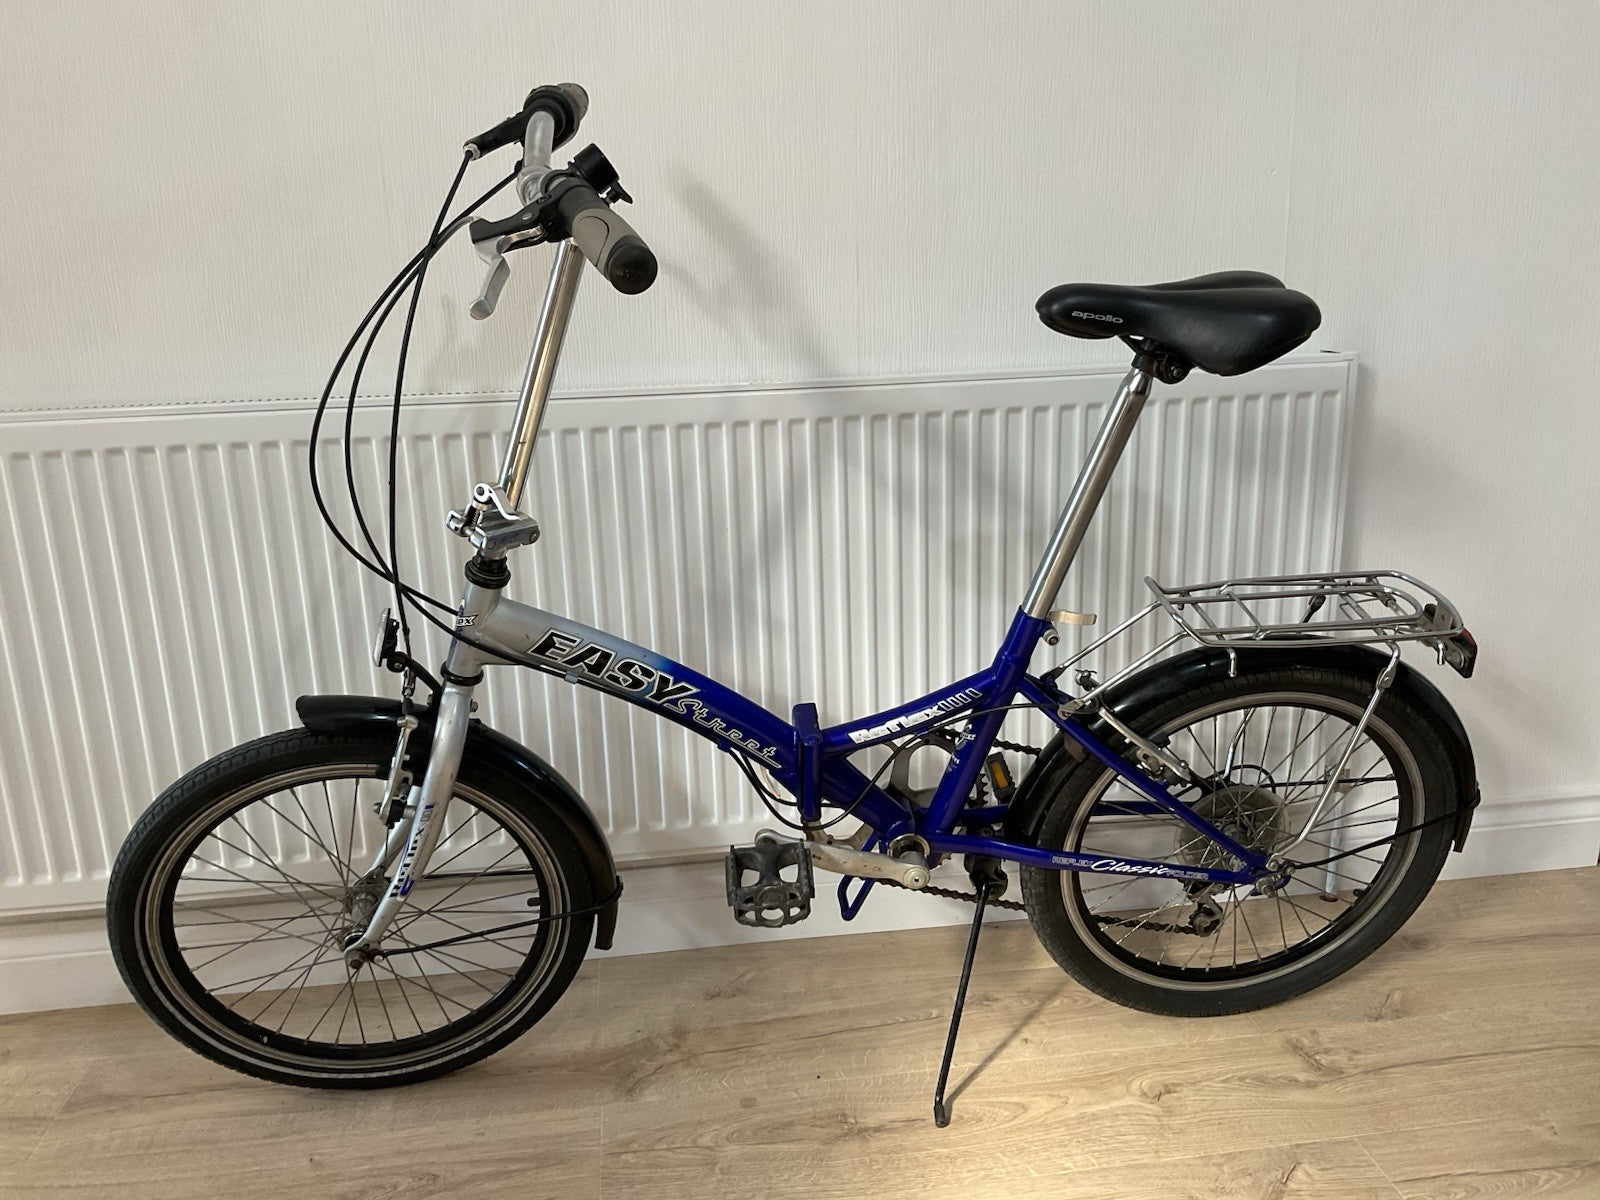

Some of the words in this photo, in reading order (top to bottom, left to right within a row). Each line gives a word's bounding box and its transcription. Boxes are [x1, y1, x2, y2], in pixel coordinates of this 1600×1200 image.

[1071, 310, 1124, 323] apollo
[526, 628, 700, 703] EASY
[664, 698, 782, 769] Street
[1051, 855, 1093, 868] REFLEX
[1090, 859, 1169, 875] Classic
